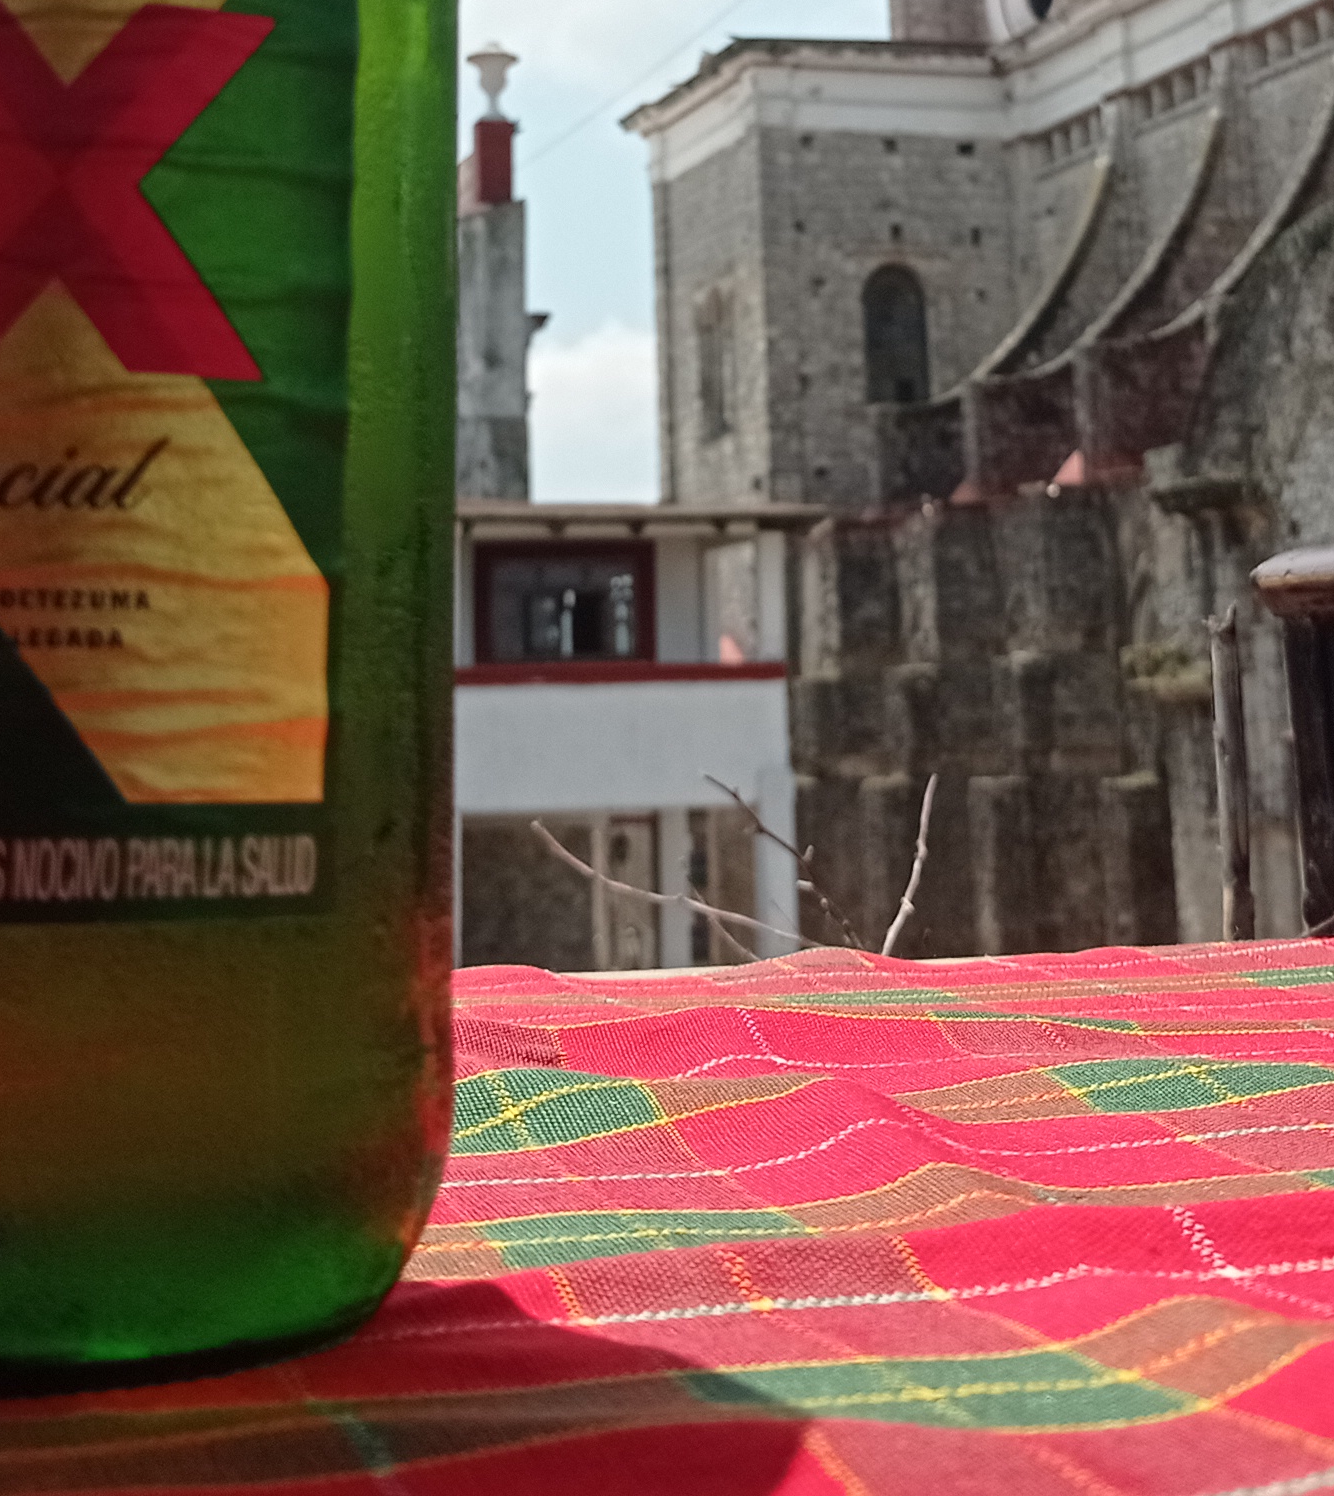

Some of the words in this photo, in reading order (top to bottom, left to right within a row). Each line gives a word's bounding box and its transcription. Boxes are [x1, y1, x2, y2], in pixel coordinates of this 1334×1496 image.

[13, 836, 120, 902] NOCIVO
[127, 837, 199, 899] PARA
[204, 837, 236, 897] LA
[240, 834, 318, 898] SALUD
